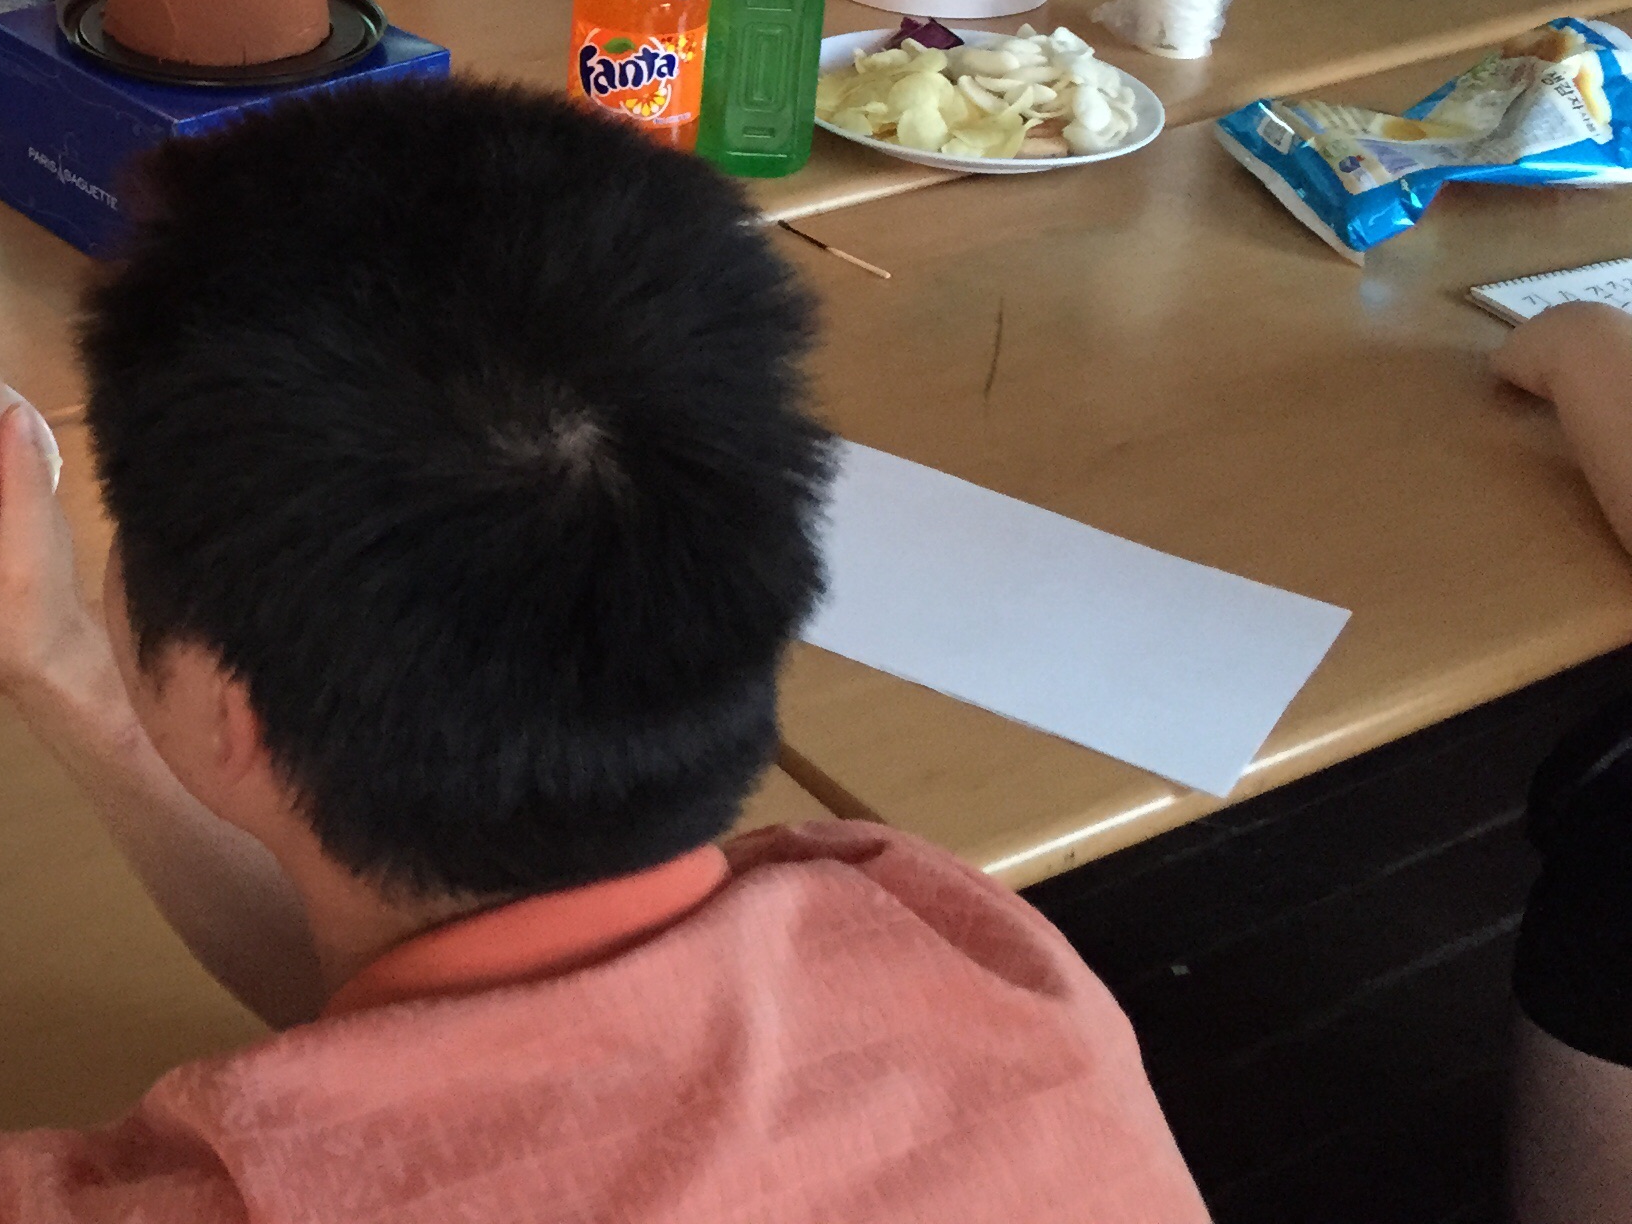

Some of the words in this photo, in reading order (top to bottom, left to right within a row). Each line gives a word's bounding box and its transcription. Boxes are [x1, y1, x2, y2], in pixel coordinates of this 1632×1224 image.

[578, 43, 677, 97] Fanta
[1540, 70, 1584, 111] 생감자
[28, 146, 58, 173] PARIS
